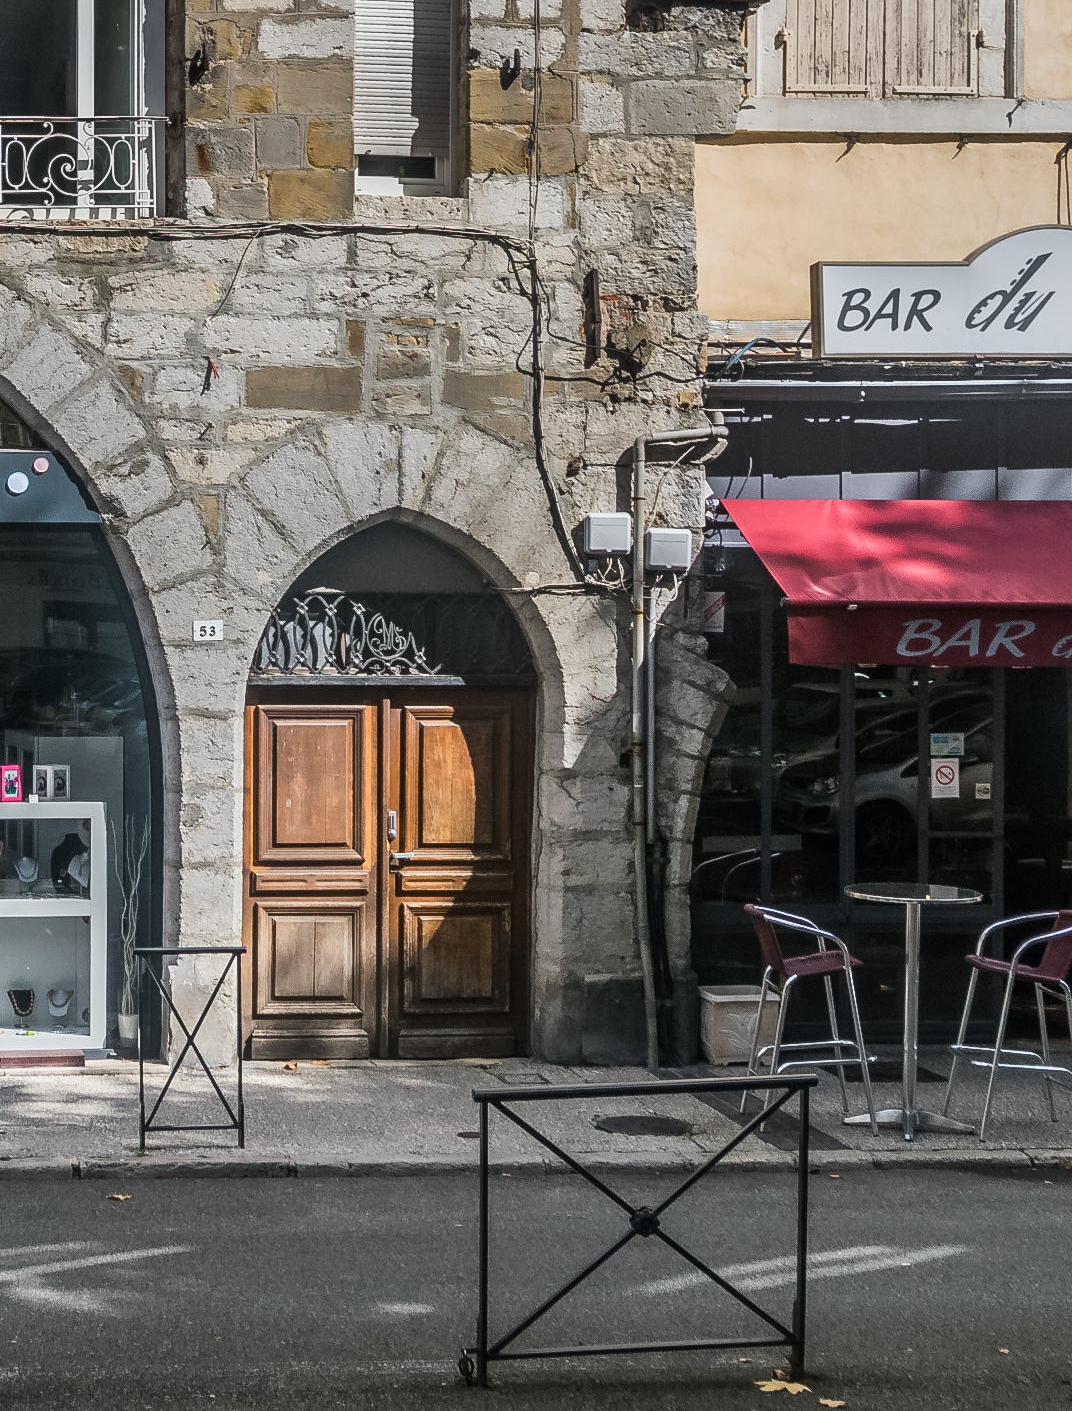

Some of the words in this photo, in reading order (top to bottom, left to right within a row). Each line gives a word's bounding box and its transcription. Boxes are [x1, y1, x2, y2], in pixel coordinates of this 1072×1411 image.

[836, 287, 942, 333] BAR
[964, 251, 1056, 333] du
[199, 625, 216, 637] 53
[896, 618, 1036, 658] BAR
